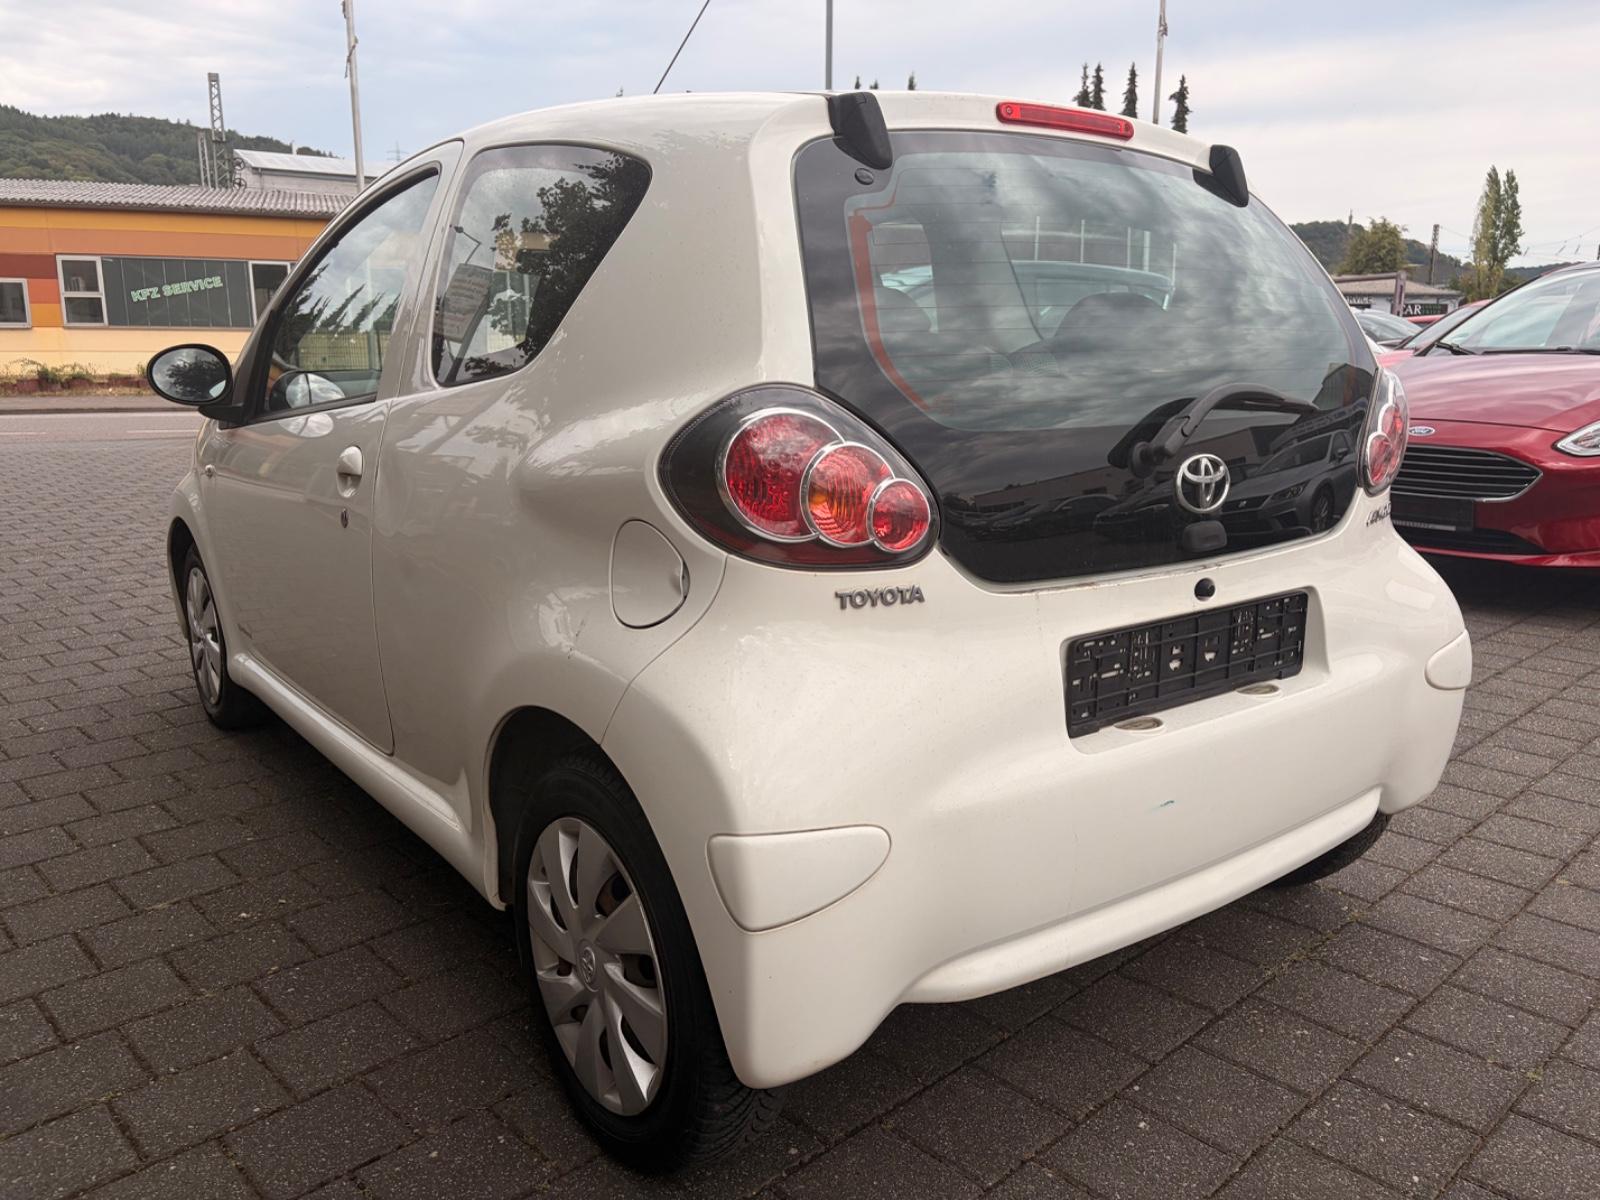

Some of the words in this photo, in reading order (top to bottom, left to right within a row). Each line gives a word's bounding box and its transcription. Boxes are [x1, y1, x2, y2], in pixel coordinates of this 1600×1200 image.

[130, 286, 160, 302] KFZ
[162, 276, 223, 297] SERVICE
[834, 584, 925, 610] TOYOTA
